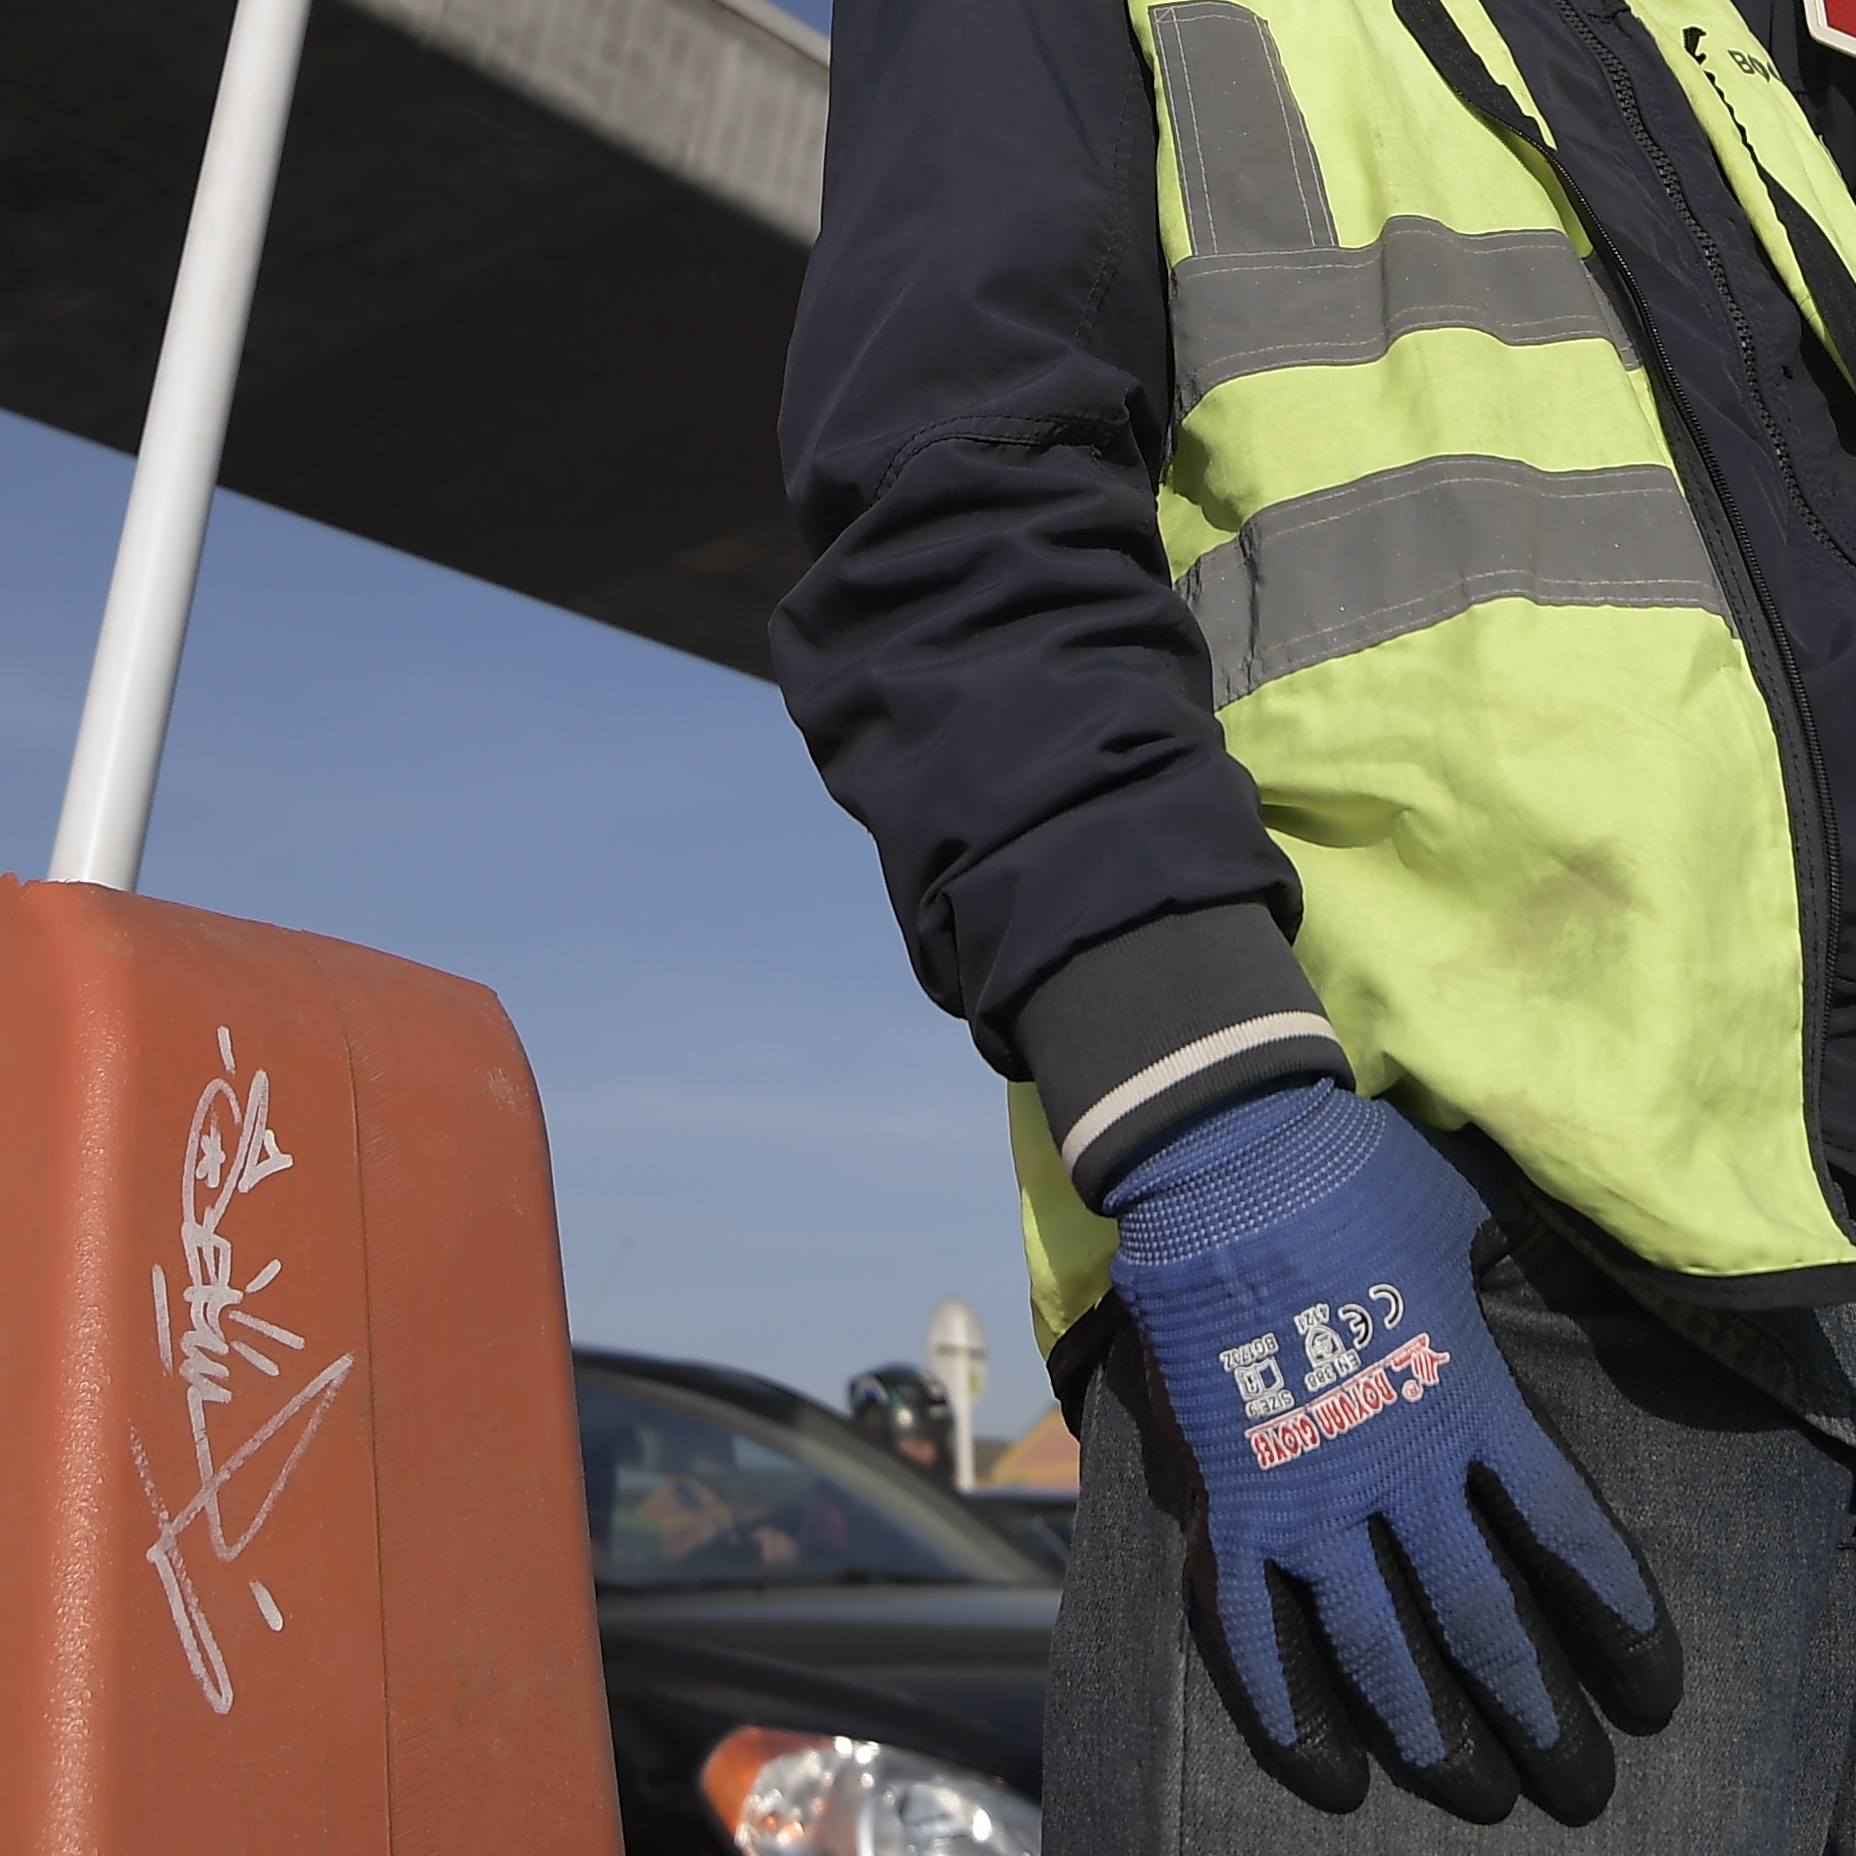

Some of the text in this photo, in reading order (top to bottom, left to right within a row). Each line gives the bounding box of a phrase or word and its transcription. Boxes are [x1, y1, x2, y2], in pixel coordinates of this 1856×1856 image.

[1306, 1349, 1361, 1390] EN 388
[1252, 1369, 1397, 1469] BOYUAN GLOVES
